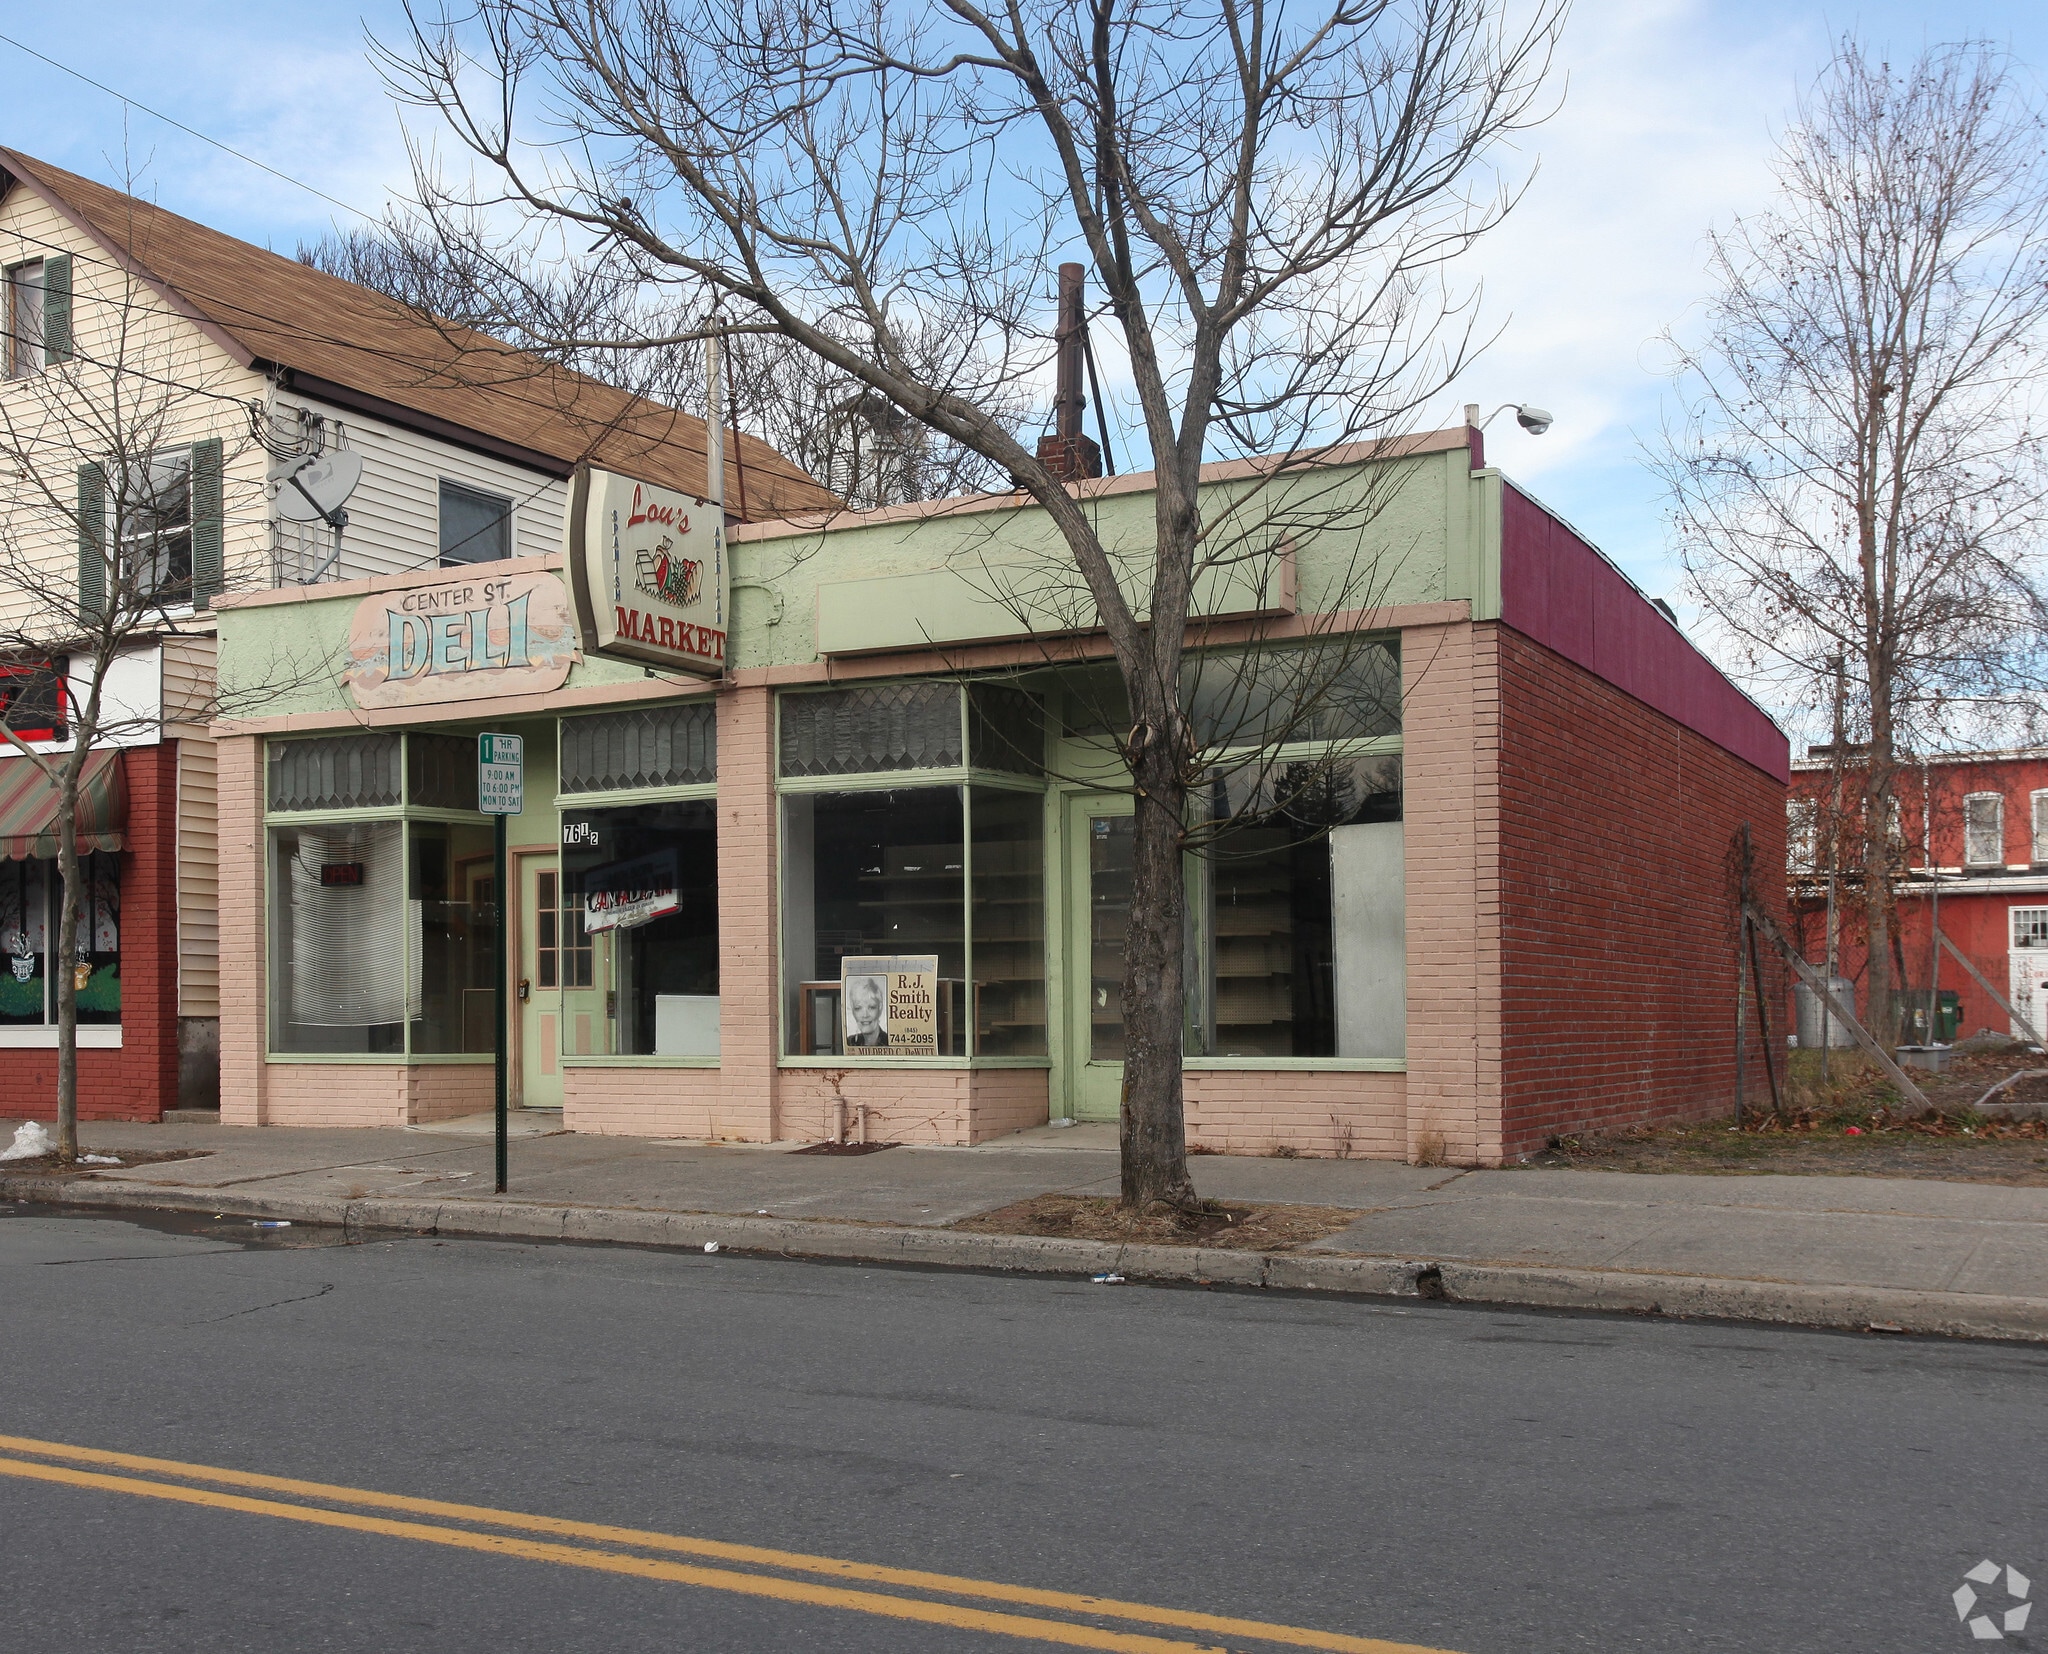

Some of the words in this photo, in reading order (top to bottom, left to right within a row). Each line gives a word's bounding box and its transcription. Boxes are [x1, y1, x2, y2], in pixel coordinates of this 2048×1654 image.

[626, 482, 692, 534] Lou's
[612, 509, 621, 602] SPANISH
[714, 526, 722, 625] AMERICAN
[402, 586, 474, 612] CENTER
[484, 580, 512, 602] ST.
[382, 588, 535, 684] DELI
[615, 605, 726, 660] MARKET
[484, 739, 489, 759] 1
[501, 740, 513, 750] HR
[494, 751, 520, 762] PARKING
[487, 769, 503, 781] 9:00
[505, 771, 515, 781] AM
[483, 782, 491, 792] TO
[492, 783, 508, 794] 6:00
[510, 784, 520, 793] PM
[482, 795, 497, 805] MON
[498, 796, 507, 806] TO
[508, 797, 520, 807] SAT
[323, 864, 358, 884] OPEN
[898, 974, 924, 989] R.J.
[890, 990, 930, 1004] Smith
[889, 1005, 932, 1022] Realty
[889, 1034, 934, 1044] 744-2095
